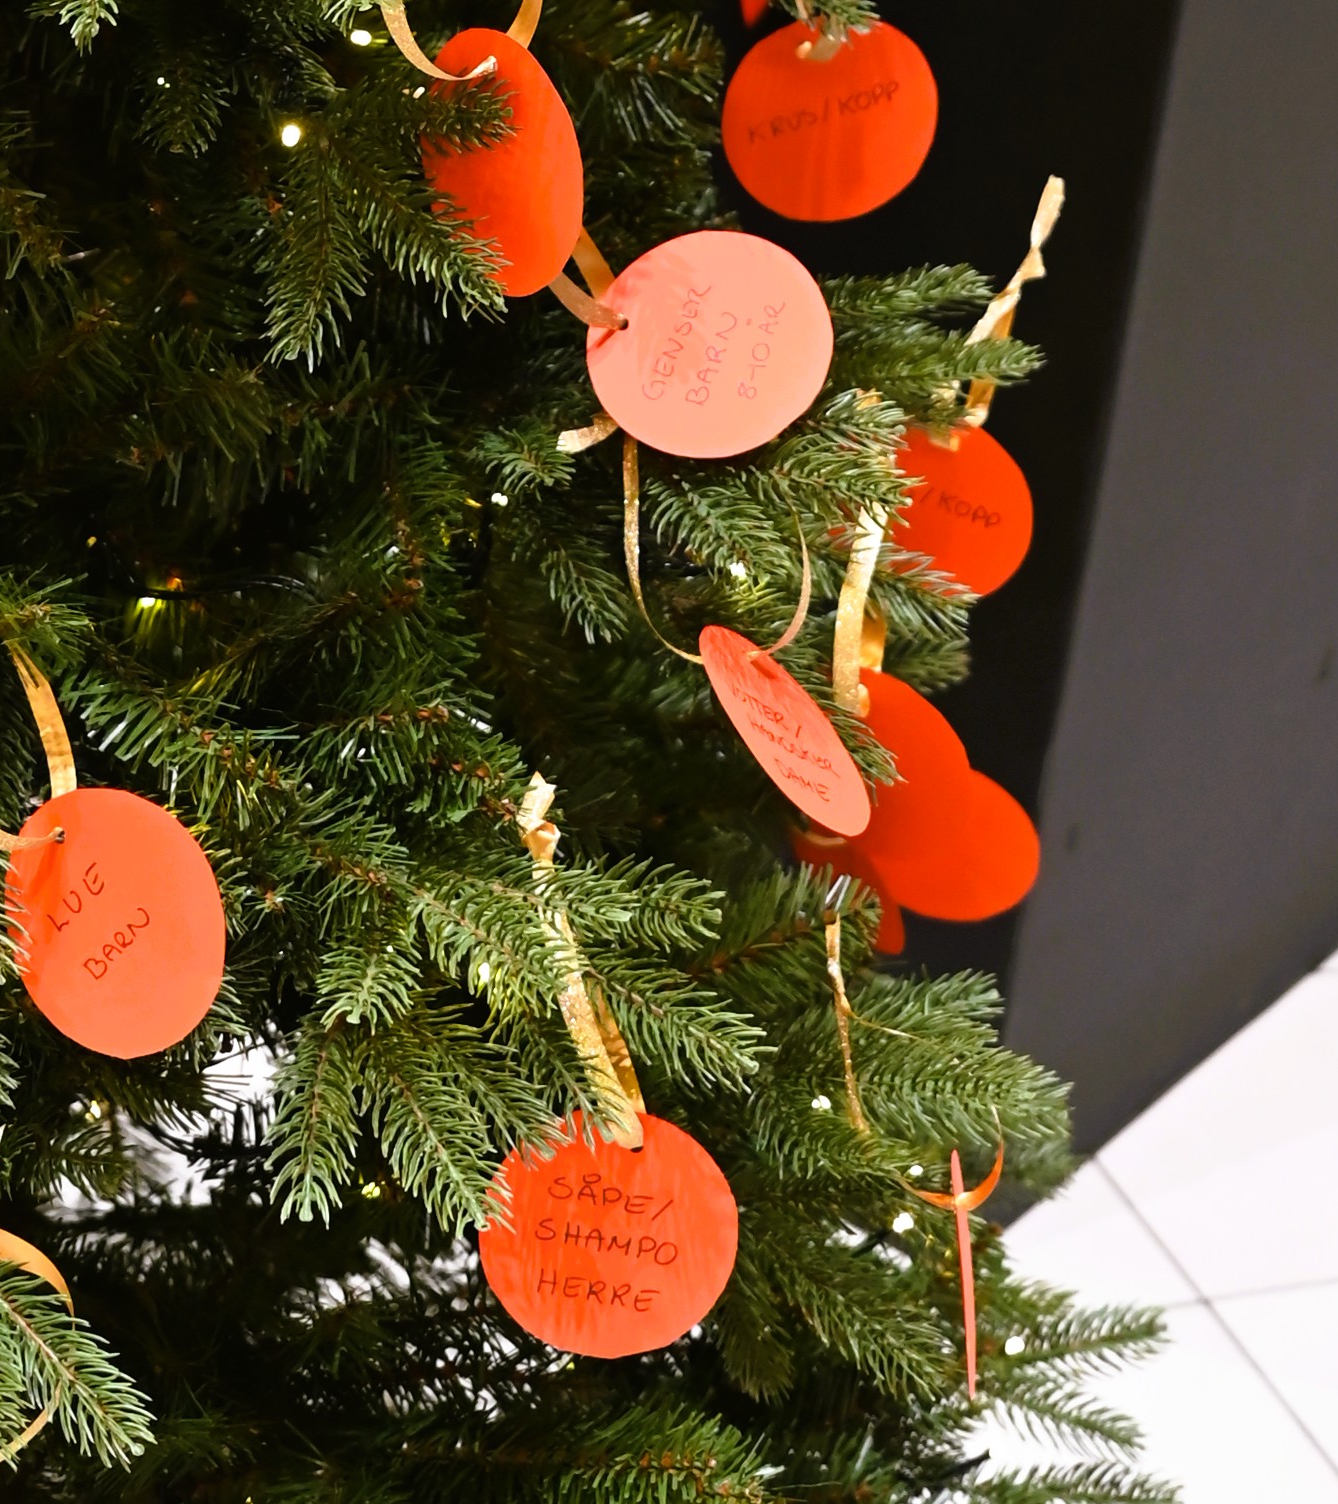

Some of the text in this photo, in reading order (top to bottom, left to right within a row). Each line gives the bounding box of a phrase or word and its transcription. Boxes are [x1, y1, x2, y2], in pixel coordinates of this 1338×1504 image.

[641, 285, 712, 401] GENSER
[685, 311, 738, 406] BARN
[47, 862, 106, 932] LUE
[83, 907, 151, 980] BARN
[534, 1218, 679, 1266] SHAMPO
[537, 1268, 660, 1312] HERRE
